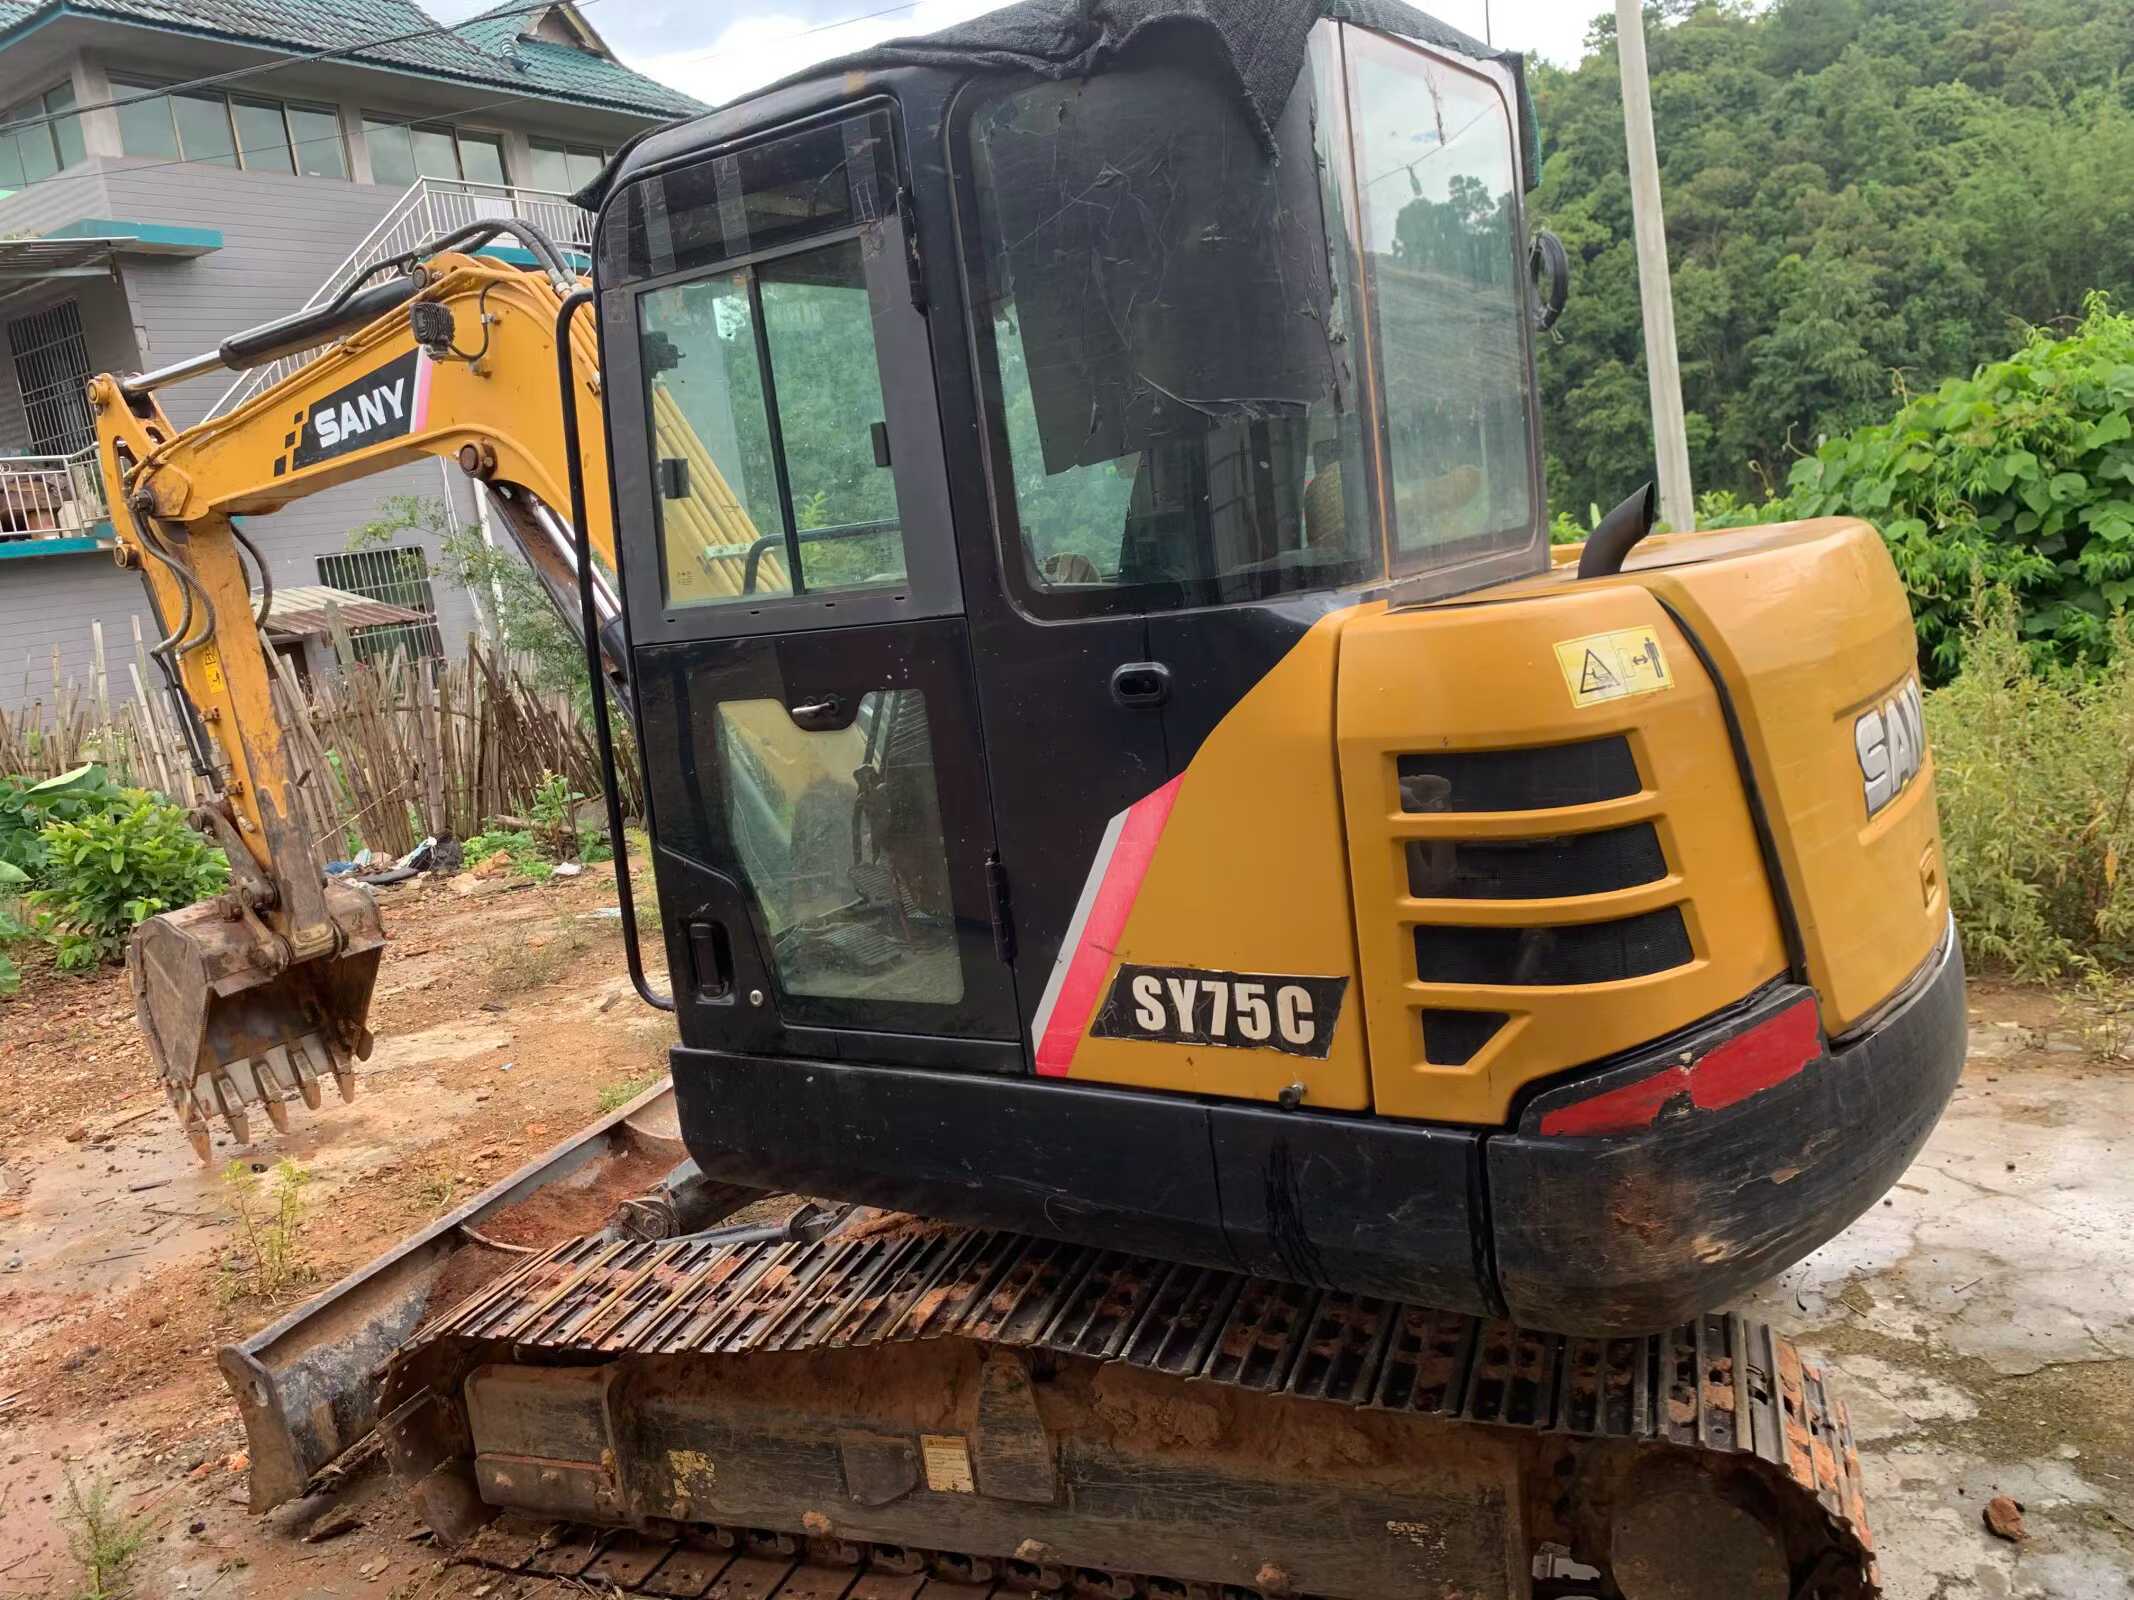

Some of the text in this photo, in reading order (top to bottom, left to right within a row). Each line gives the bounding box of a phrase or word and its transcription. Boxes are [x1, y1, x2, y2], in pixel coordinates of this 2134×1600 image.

[314, 377, 404, 448] SANY
[1855, 676, 1925, 817] SAN
[1132, 974, 1315, 1044] SY75C
